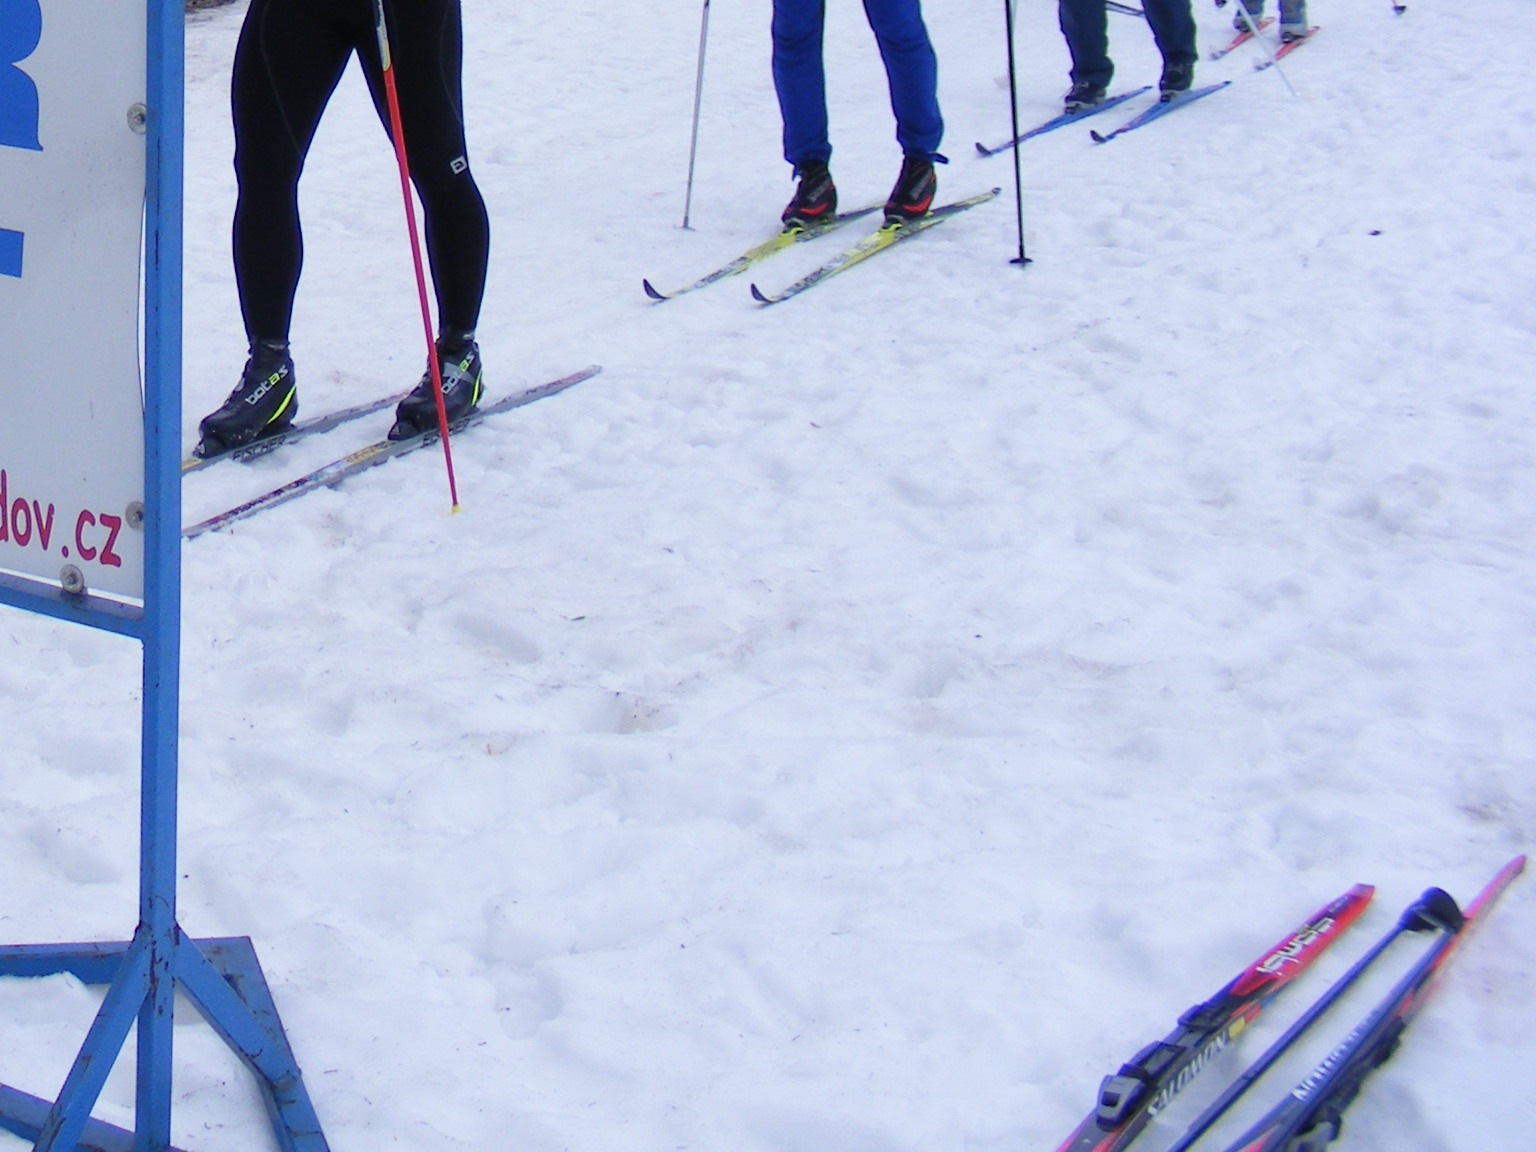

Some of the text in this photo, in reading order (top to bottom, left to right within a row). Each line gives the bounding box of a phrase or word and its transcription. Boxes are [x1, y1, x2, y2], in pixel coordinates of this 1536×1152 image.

[244, 364, 290, 406] botas
[232, 436, 287, 462] FISCHER
[1147, 1027, 1231, 1117] SALOMON
